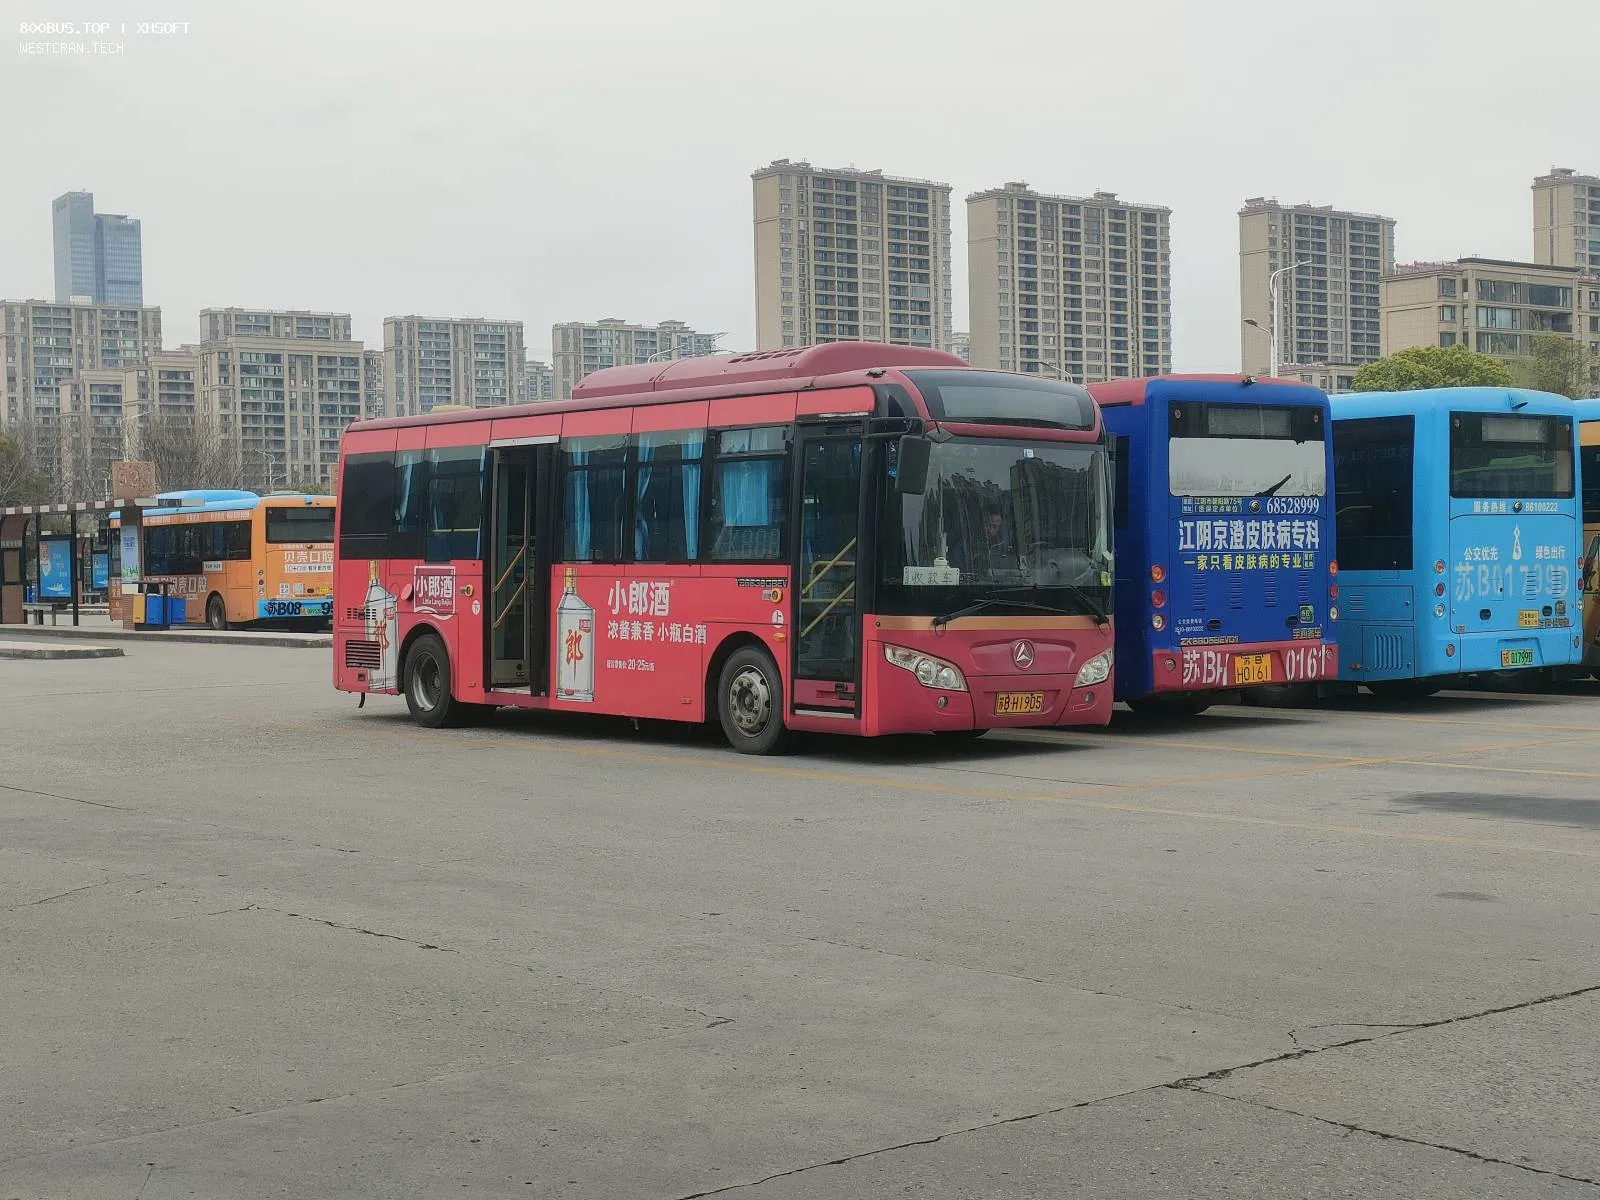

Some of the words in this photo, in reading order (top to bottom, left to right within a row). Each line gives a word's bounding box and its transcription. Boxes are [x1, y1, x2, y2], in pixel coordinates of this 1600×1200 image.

[1266, 498, 1320, 514] 68528999
[1178, 520, 1320, 551] 江阴京澄皮肤病专科
[1183, 553, 1302, 571] 一家只看皮肤病的专业
[1464, 546, 1499, 561] 公交优先
[415, 575, 453, 598] 小郎酒
[911, 571, 953, 585] 收款车
[607, 580, 670, 617] 小郎酒
[607, 620, 654, 641] 浓酱兼香
[657, 622, 707, 645] 小瓶白酒
[1236, 664, 1270, 684] H0161
[1285, 645, 1326, 682] 0161
